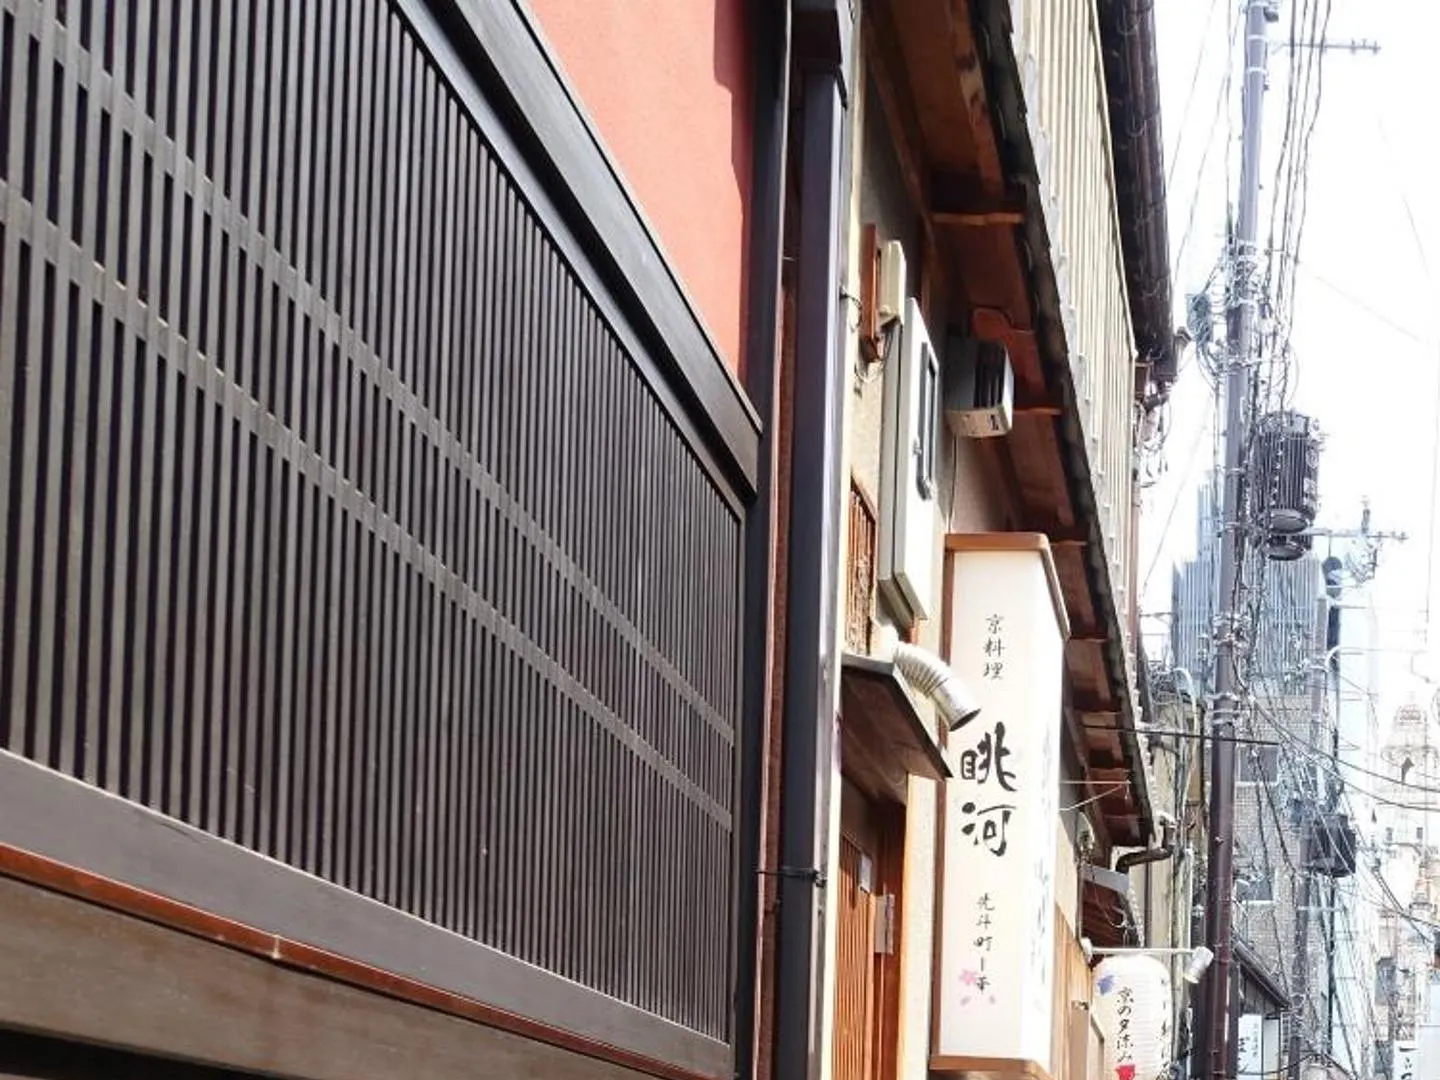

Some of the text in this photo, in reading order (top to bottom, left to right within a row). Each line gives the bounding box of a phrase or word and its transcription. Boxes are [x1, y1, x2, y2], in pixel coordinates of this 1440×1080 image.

[983, 613, 1006, 680] 京料理
[960, 721, 1017, 857] 眺河
